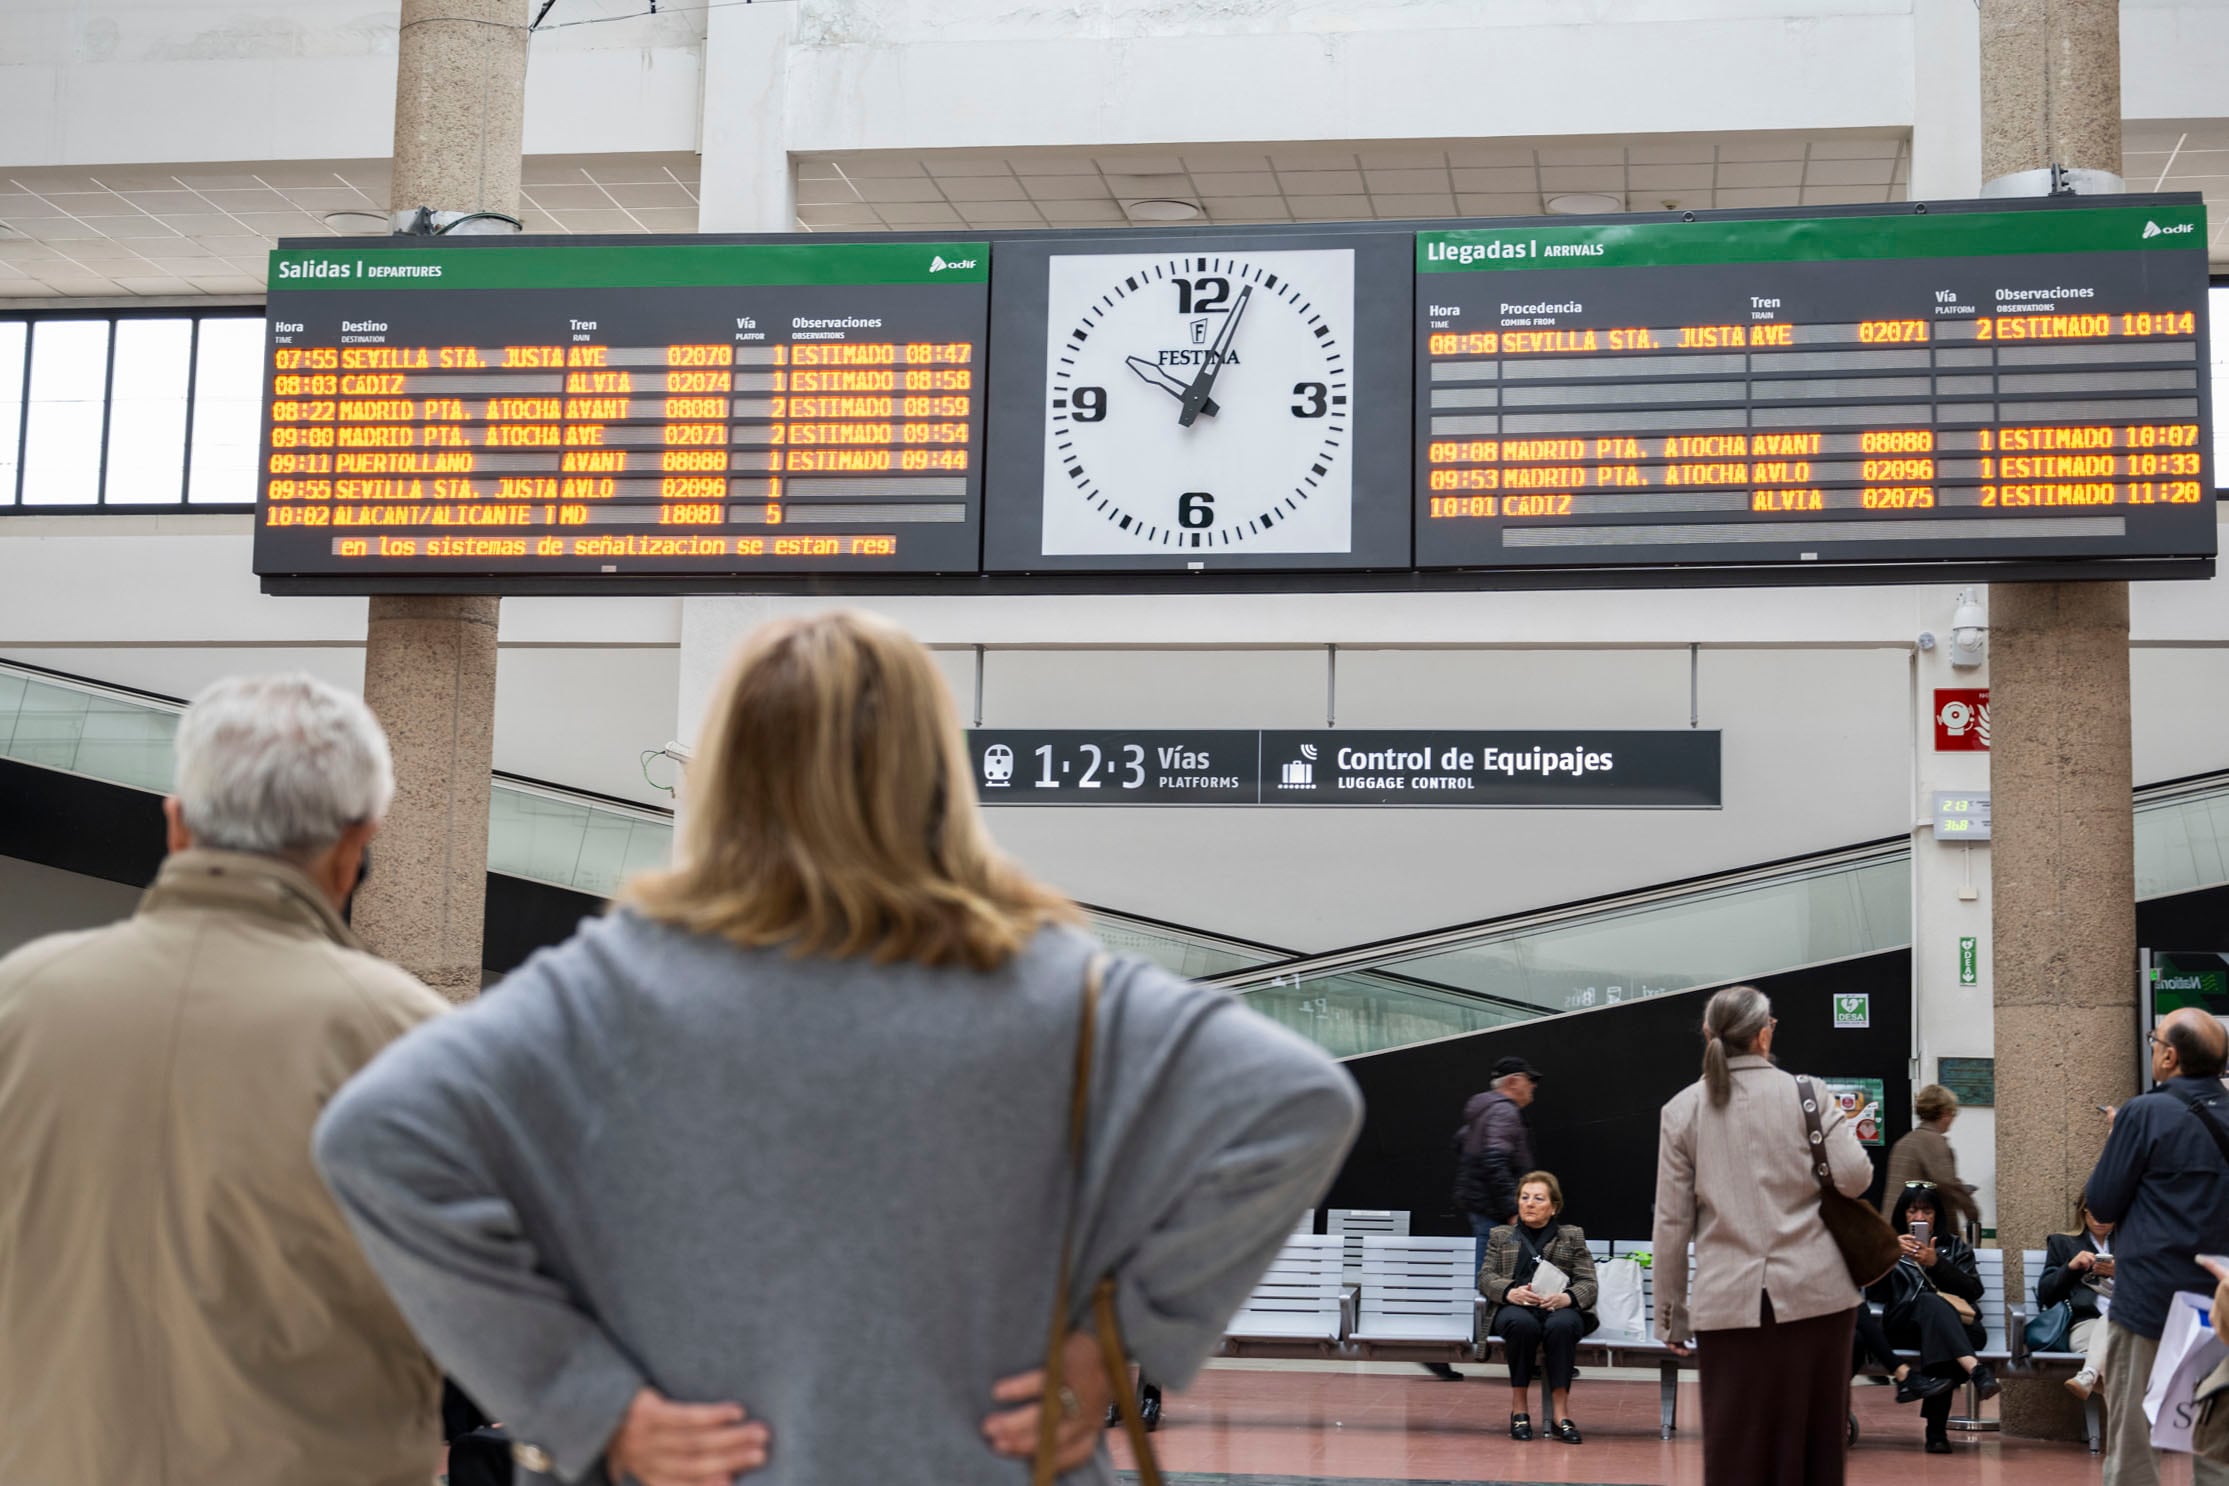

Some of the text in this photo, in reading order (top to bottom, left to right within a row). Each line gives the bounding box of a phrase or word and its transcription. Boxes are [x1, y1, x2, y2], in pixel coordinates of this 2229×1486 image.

[2161, 223, 2194, 235] adif
[948, 259, 977, 269] adif
[1428, 240, 1604, 264] Llegadas ARRIVALS
[278, 260, 442, 279] Salidas DEPARTURES
[1171, 277, 1230, 315] 12
[1429, 286, 2094, 317] Hora Procedencia Tren Vía Observaciones
[275, 316, 882, 333] Hora Destino Tren Vía Observaciones
[1430, 303, 2055, 329] TIME COMING FROM TRAIN PLATFORM OBSERVATIONS
[275, 336, 293, 344] TIME
[341, 335, 386, 344] DESTINATION
[791, 332, 845, 340] OBSERVATIONS
[1430, 313, 2194, 355] 08:58 SEVILLA STA. JUSTA AVE 02071 2 ESTIMADO 10:14
[275, 344, 971, 369] 07:55 SEVILLA STA. JUSTA AVE 02070 1 ESTIMADO 08:47
[1158, 349, 1241, 366] FESTINA
[275, 375, 337, 395] 08:03
[566, 373, 633, 393] ALVIA
[665, 372, 731, 393] 02074
[773, 372, 786, 392] 1
[790, 371, 896, 392] ESTIMADO
[904, 370, 971, 390] 08:58
[273, 396, 969, 421] 08:22 MADRID PTA. ATOCHA AVANT 08081 2 ESTIMADO 08:59
[1071, 386, 1107, 423] 9
[1290, 382, 1328, 419] 3
[272, 423, 969, 448] 09:00 MADRID PTA. ATOCHA AVE 02071 2 ESTIMADO 09:54
[1429, 425, 2198, 463] 09:08 MADRID PTA. ATOCHA AVANT 08080 1 ESTIMADO 10:07
[270, 450, 967, 473] 09:11 PUERTOLLANO AVANT 08080 1 ESTIMADO 09:44
[1430, 453, 2200, 490] 09:53 MADRID PTA. ATOCHA AVLO 02096 1 ESTIMADO 10:33
[269, 478, 781, 500] 09:55 SEVILLA STA. JUSTA AVLO 02096 1
[1430, 496, 1496, 518] 10:01
[1753, 489, 1823, 511] ALVIA
[1862, 487, 1933, 509] 02075
[1981, 486, 1996, 507] 2
[2001, 483, 2115, 506] ESTIMADO
[2128, 482, 2200, 504] 11:20
[267, 504, 781, 526] 10:02 ALACANT/ALICANTE T MD 18081 5
[1177, 492, 1215, 529] 6
[339, 535, 896, 556] en los sistemas de señalizacion se estan reg
[1158, 745, 1210, 770] Vías
[1337, 745, 1614, 777] Control de Equipajes
[1159, 776, 1239, 789] PLATFORMS
[1338, 776, 1475, 789] LUGGAGE CONTROL
[1964, 951, 1973, 974] DEA
[1838, 1013, 1865, 1021] DESA
